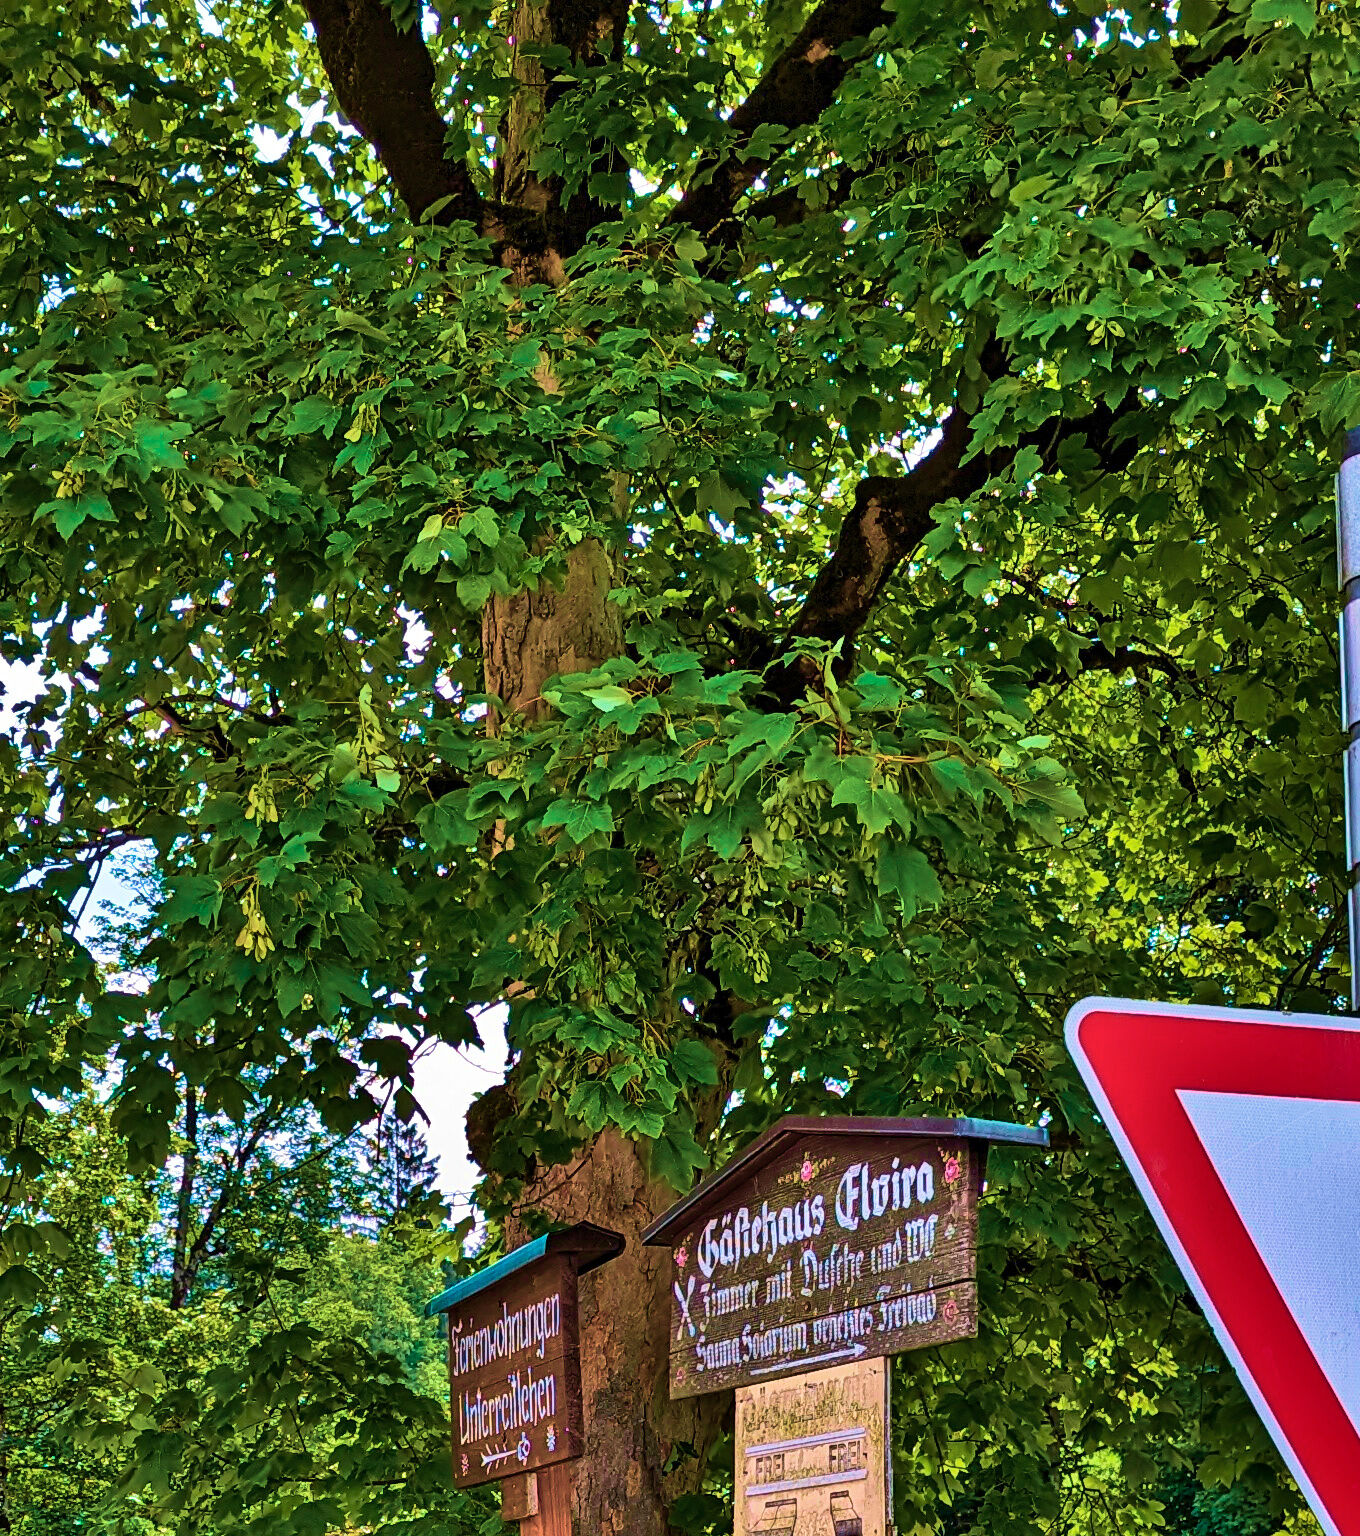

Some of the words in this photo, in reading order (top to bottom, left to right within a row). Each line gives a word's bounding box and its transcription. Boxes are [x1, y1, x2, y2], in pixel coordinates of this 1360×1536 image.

[697, 1193, 825, 1279] Gästehaus
[835, 1157, 936, 1231] Elvira
[700, 1279, 759, 1331] Zimmer
[766, 1260, 792, 1306] mit
[870, 1231, 902, 1275] und
[906, 1214, 939, 1263] WC
[452, 1292, 560, 1377] Ferienwohnungen
[459, 1366, 556, 1445] Unterreitlehen
[828, 1440, 861, 1472] FREI
